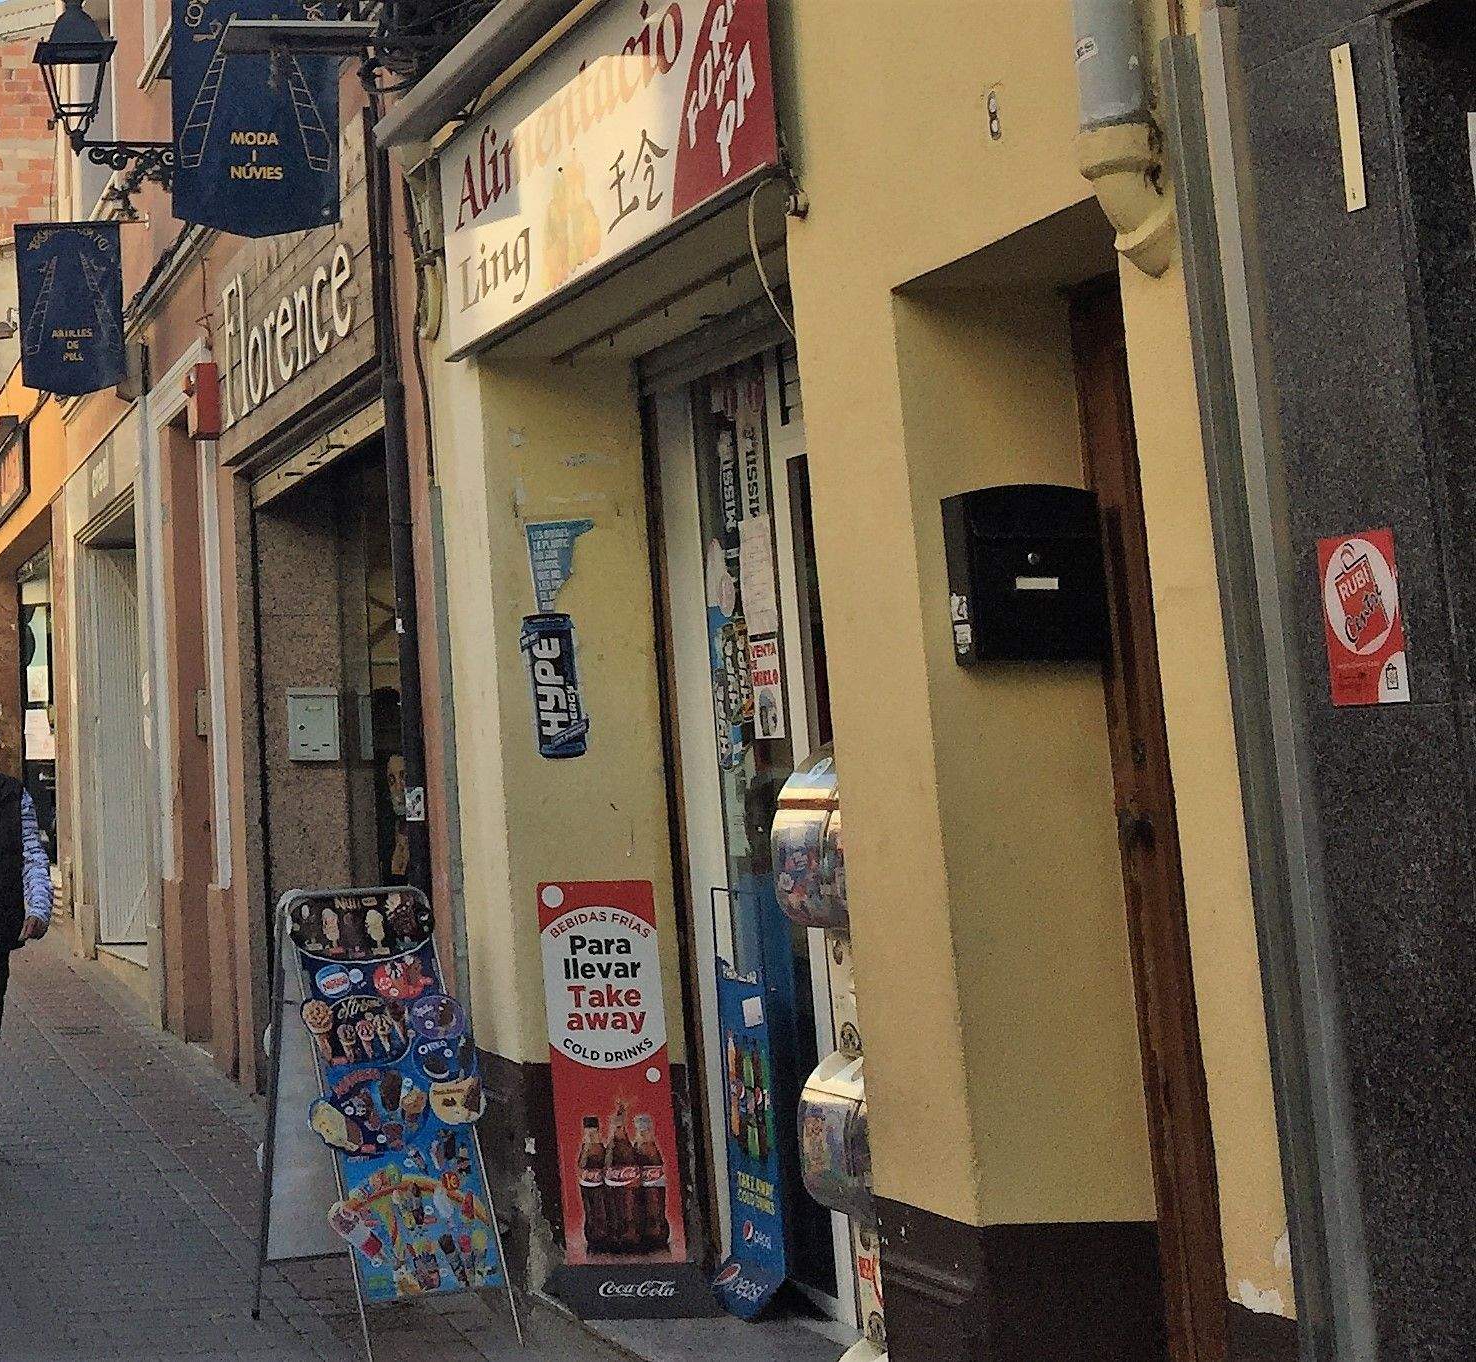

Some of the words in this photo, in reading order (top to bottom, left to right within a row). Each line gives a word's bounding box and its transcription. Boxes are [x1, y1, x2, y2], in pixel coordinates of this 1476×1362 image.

[230, 131, 279, 146] MODA
[251, 149, 258, 162] I
[230, 161, 284, 180] NÚVIES
[458, 227, 531, 313] Ling
[222, 244, 354, 430] Florence
[532, 637, 568, 737] HYPE
[549, 911, 607, 939] BEBIDAS
[568, 935, 632, 956] Para
[563, 957, 642, 980] llevar
[567, 984, 643, 1009] Take
[566, 1011, 647, 1035] away
[563, 1037, 601, 1061] COLD
[603, 1037, 655, 1063] DRINKS
[598, 1280, 677, 1297] Coca-Cola
